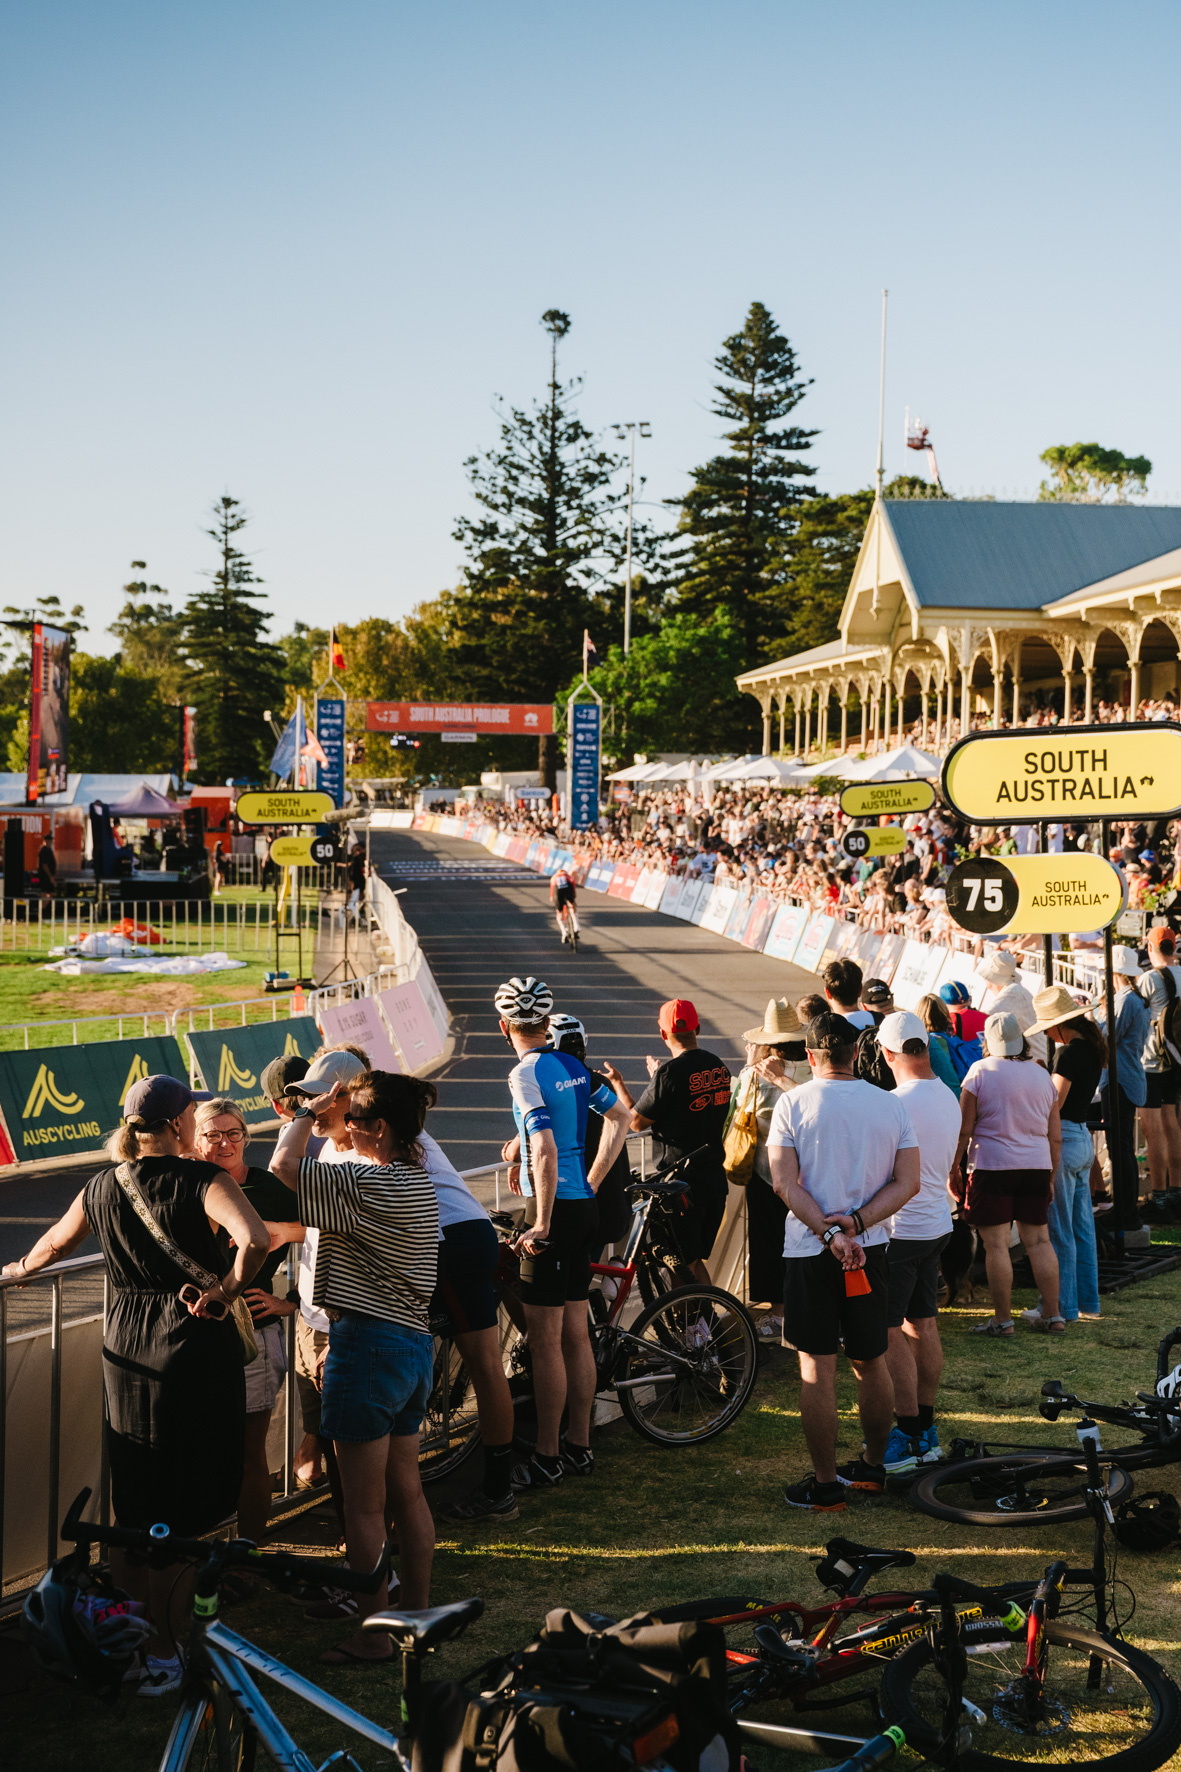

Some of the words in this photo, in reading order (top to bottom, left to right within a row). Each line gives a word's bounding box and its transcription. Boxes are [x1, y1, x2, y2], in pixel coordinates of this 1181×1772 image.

[1024, 749, 1108, 775] SOUTH
[870, 789, 901, 799] SOUTH
[995, 776, 1138, 803] AUSTRALIA
[268, 798, 300, 807] SOUTH
[861, 798, 912, 810] AUSTRALIA
[257, 808, 311, 817] AUSTRALIA
[849, 837, 866, 850] 50
[316, 844, 334, 857] 50
[1044, 880, 1087, 893] SOUTH
[962, 878, 1003, 913] 75
[1031, 893, 1102, 908] AUSTRALIA
[563, 1076, 587, 1089] GIANT
[689, 1066, 731, 1091] SDCC
[22, 1121, 101, 1147] AUSCYCLING
